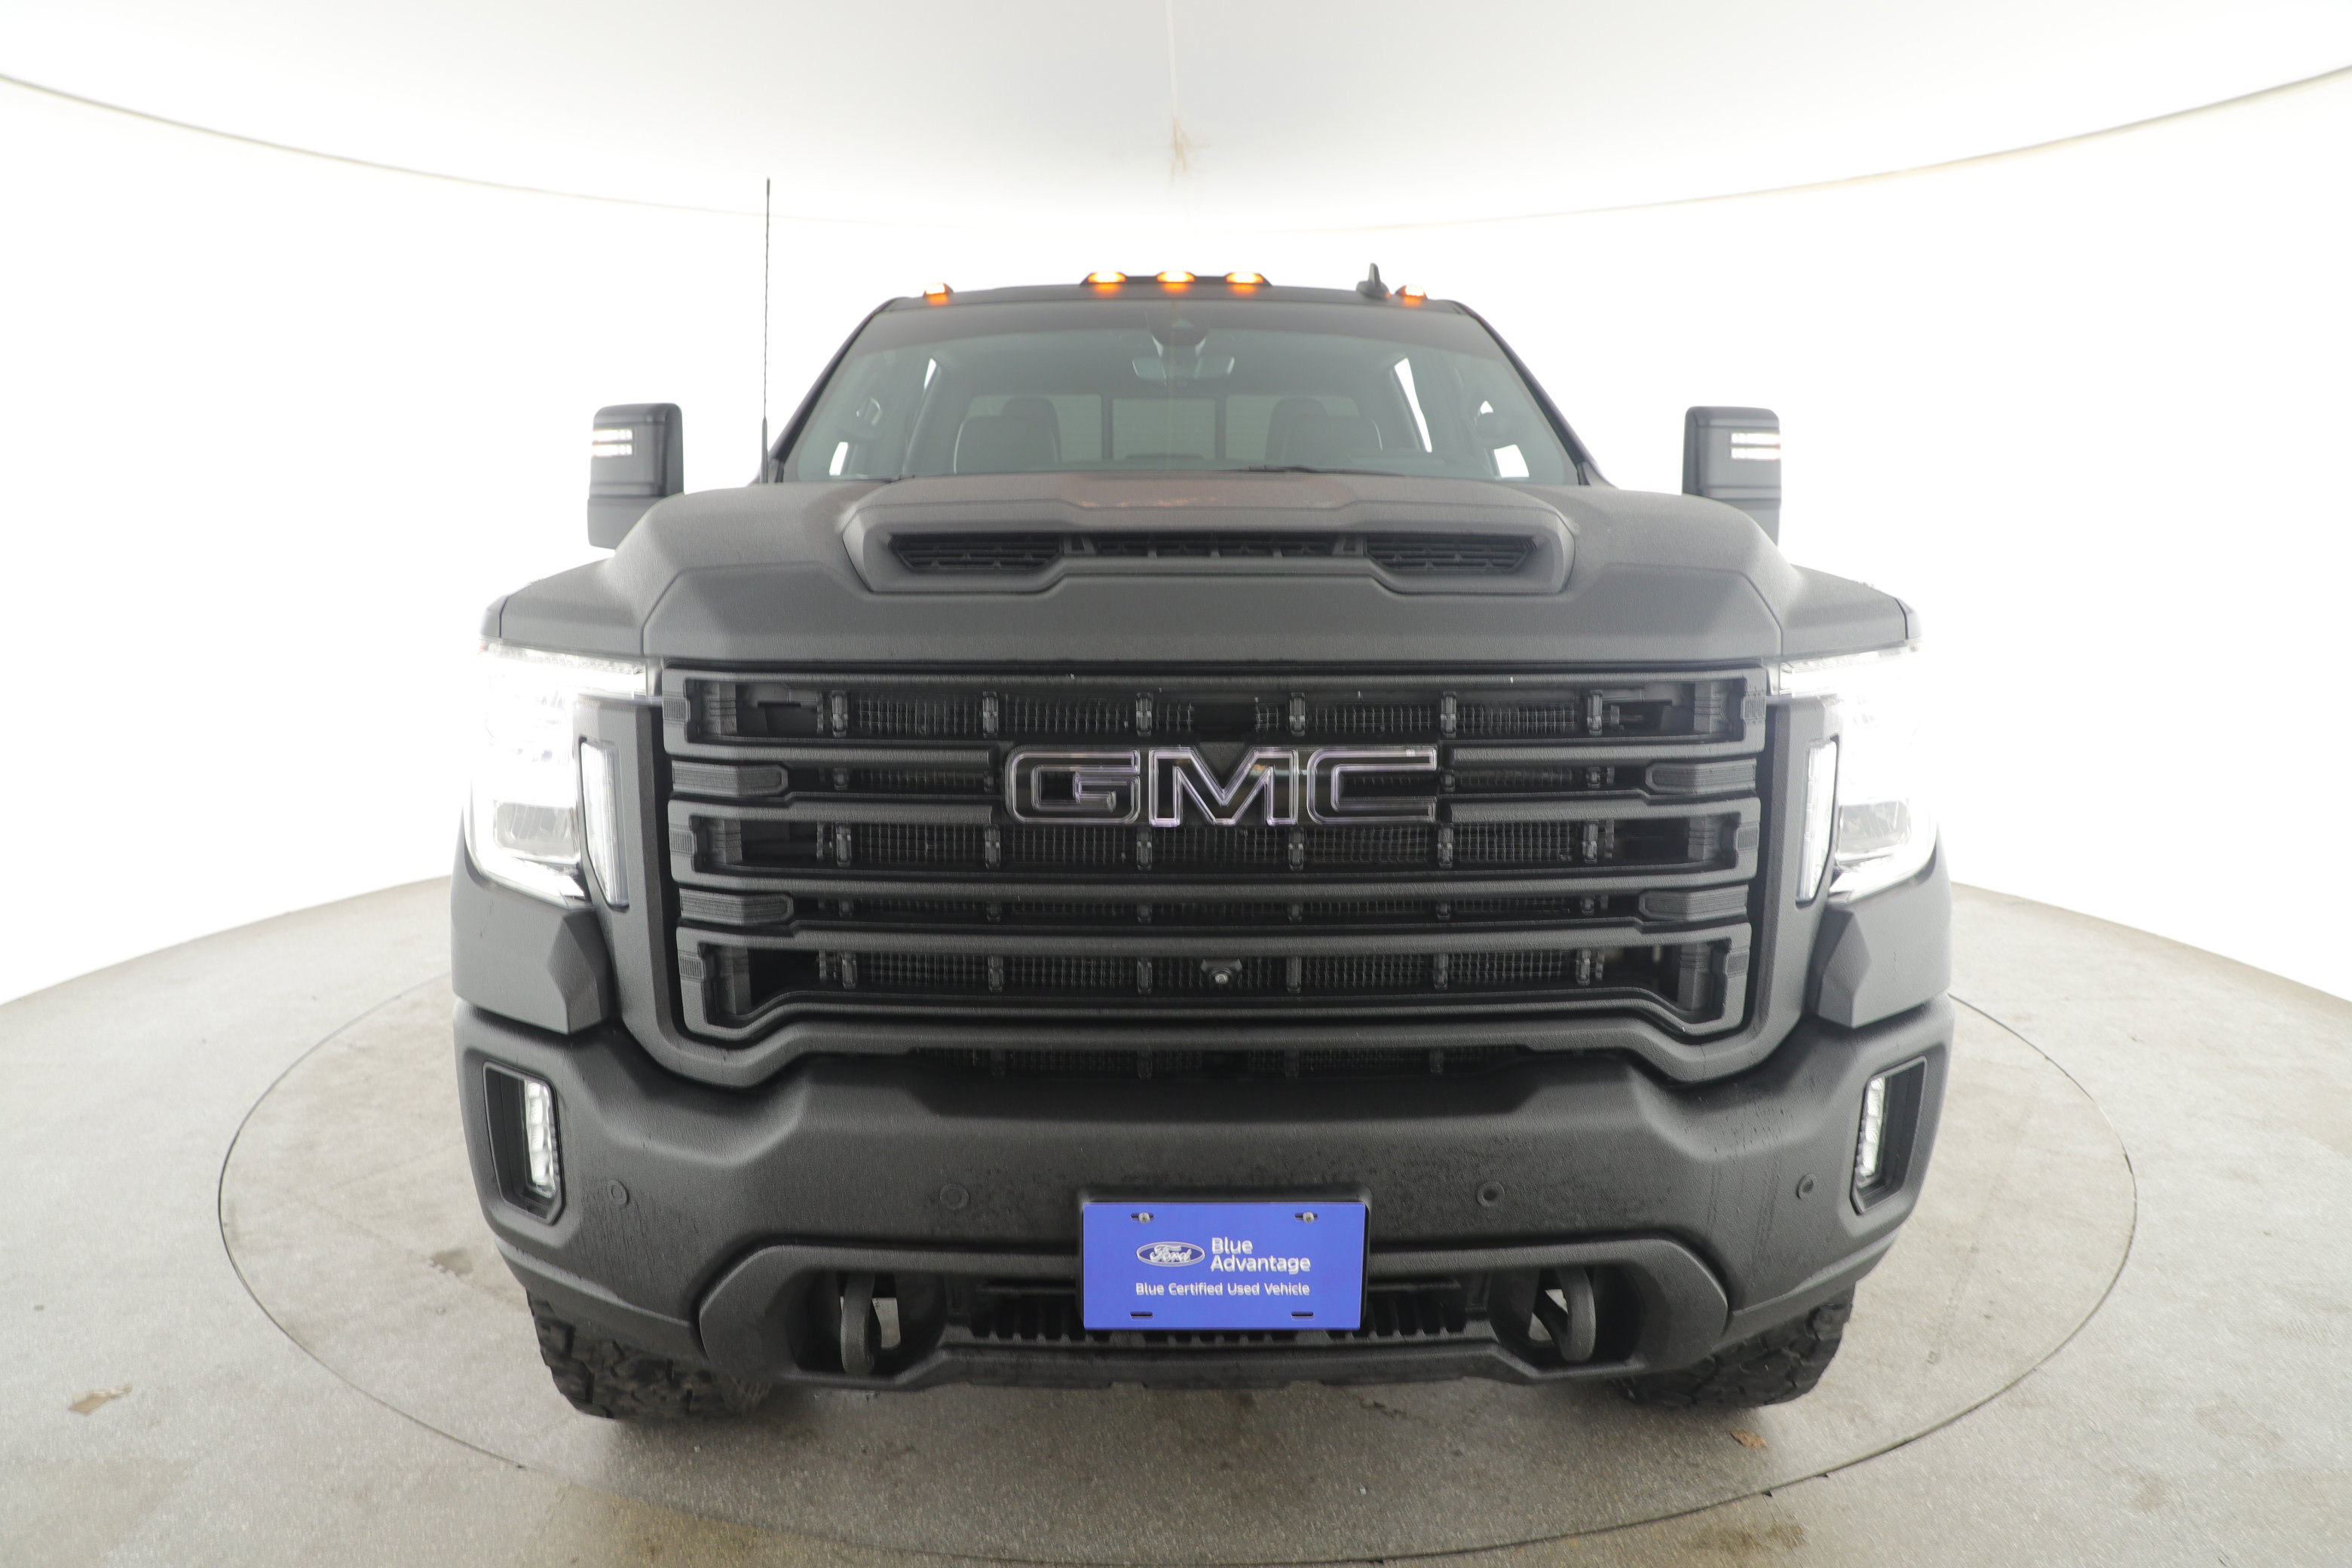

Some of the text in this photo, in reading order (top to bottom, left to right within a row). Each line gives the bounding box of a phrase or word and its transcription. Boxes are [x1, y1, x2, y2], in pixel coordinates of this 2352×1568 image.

[1006, 746, 1438, 827] GMC
[1150, 1245, 1192, 1263] Ford
[1211, 1237, 1253, 1254] Blue
[1211, 1254, 1311, 1275] Advantage
[1135, 1282, 1310, 1295] Blue Certified Used Vehicle
